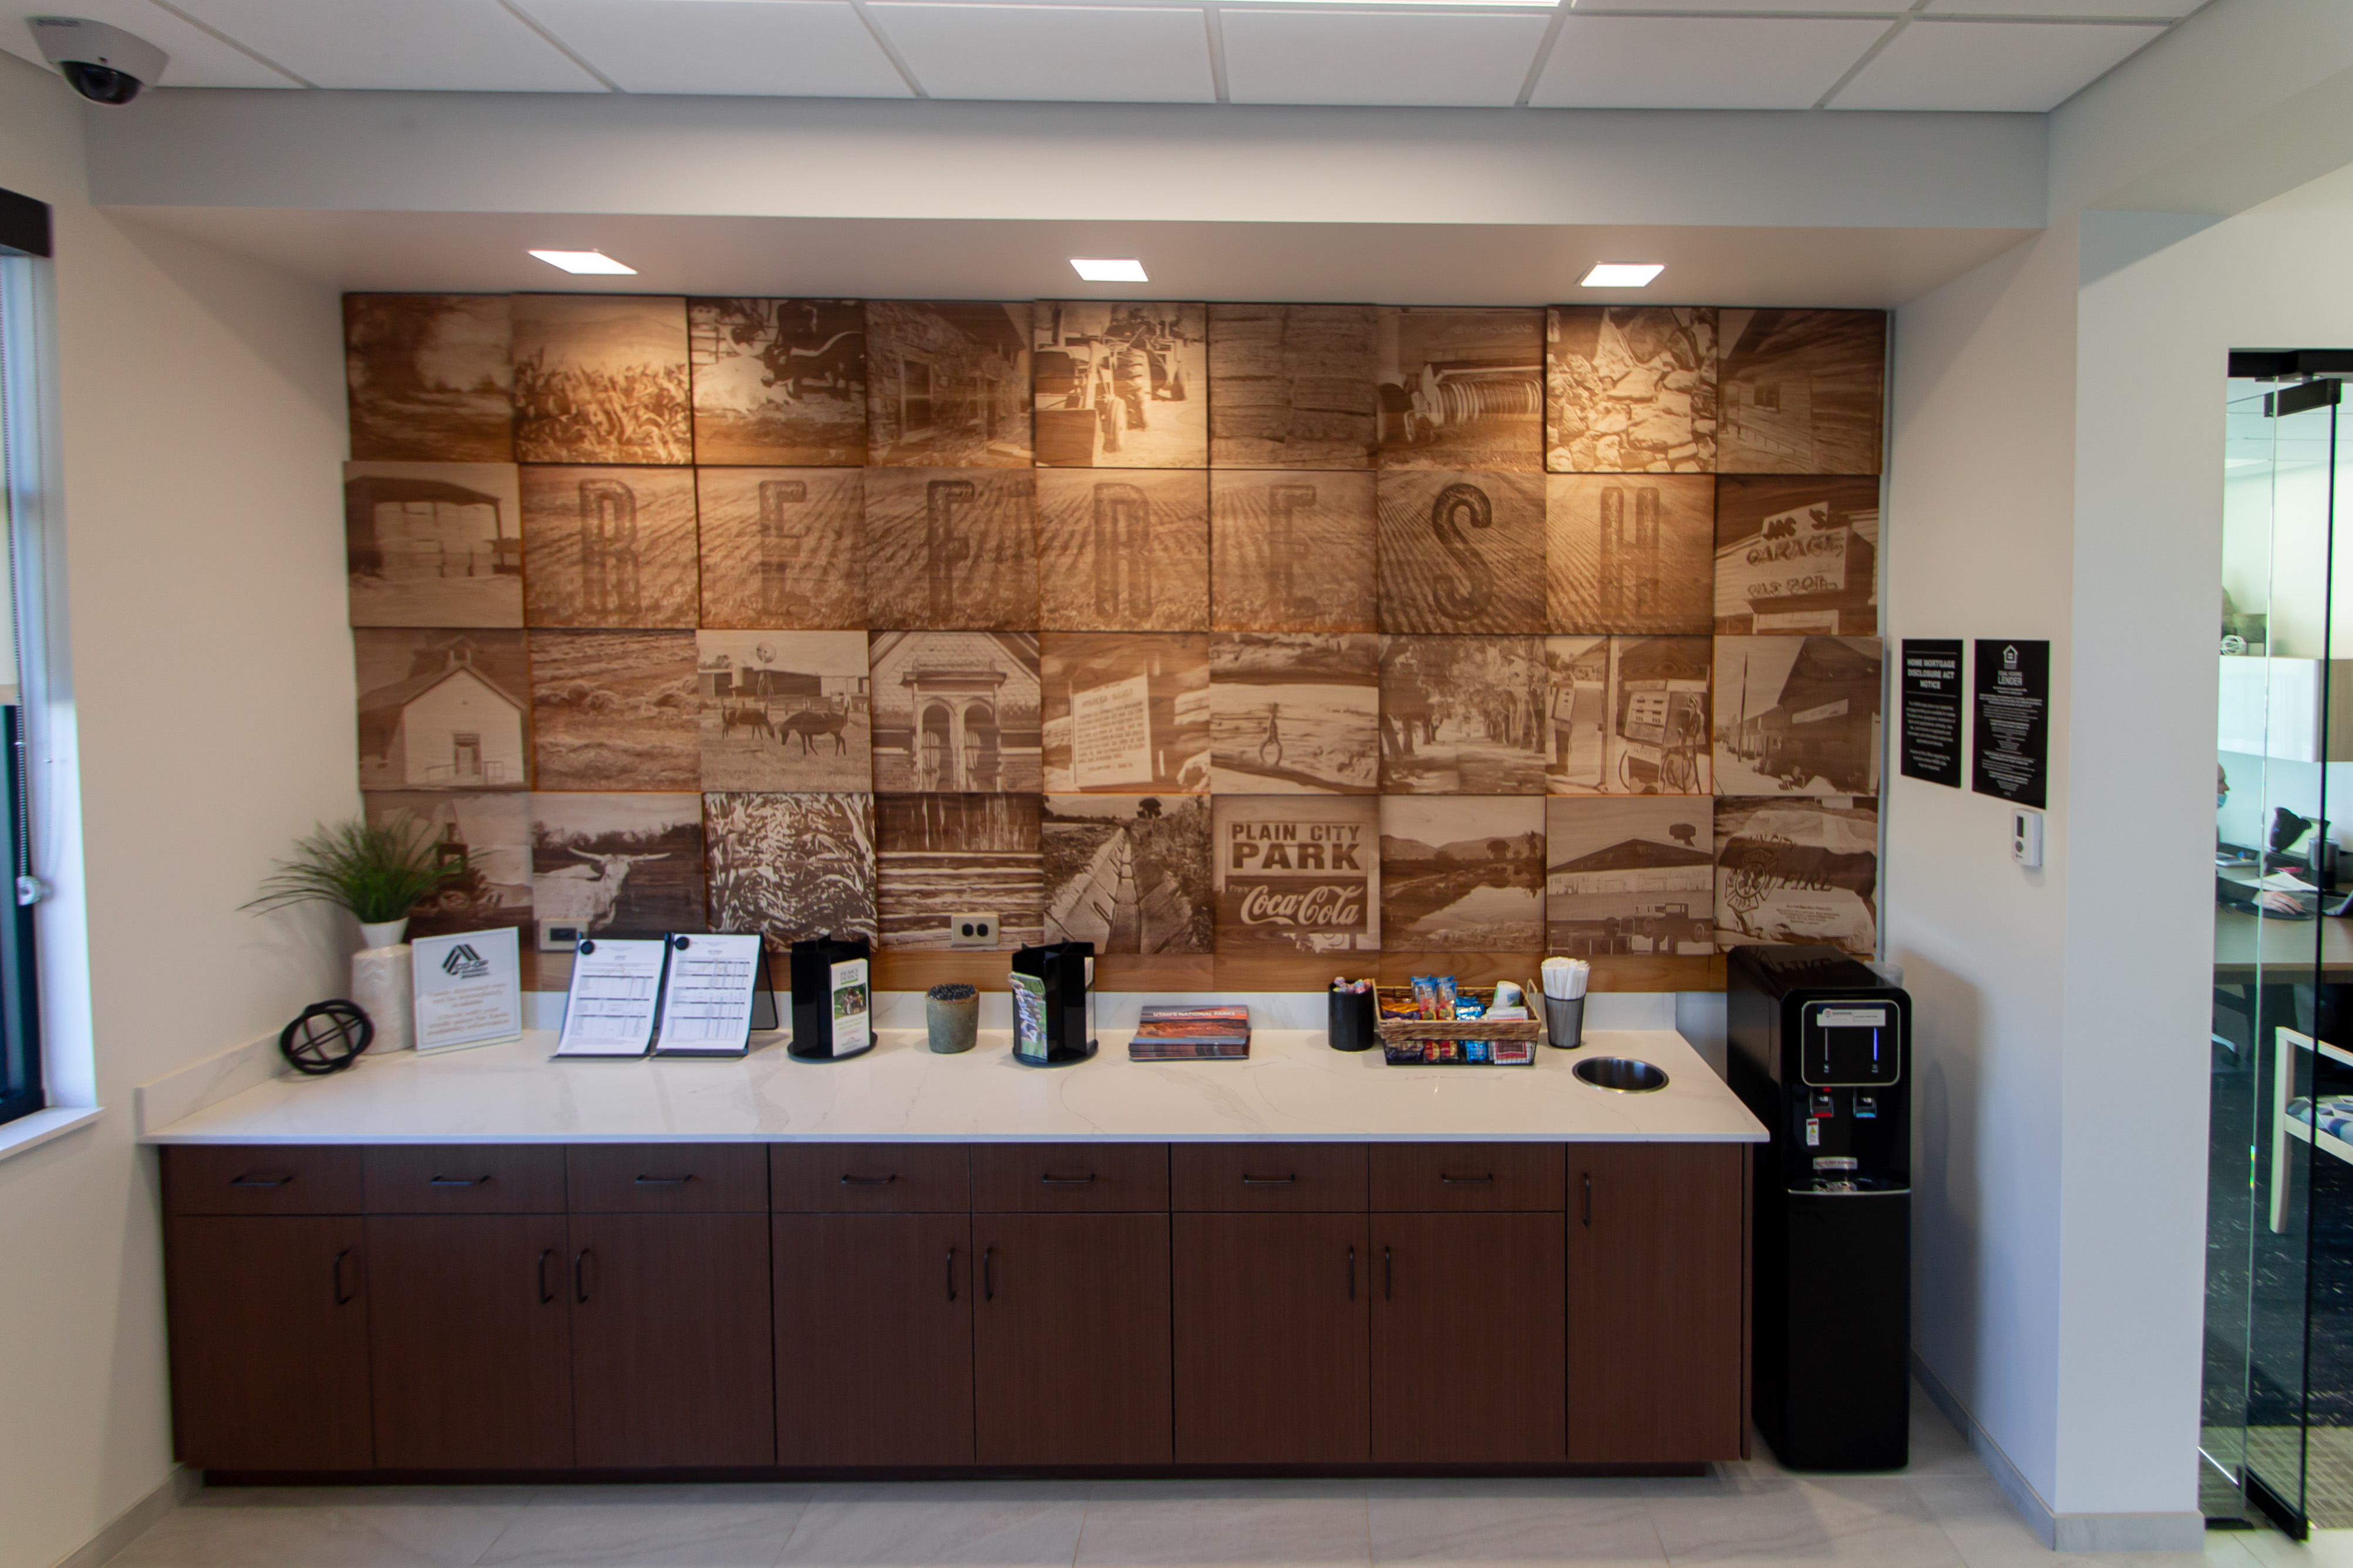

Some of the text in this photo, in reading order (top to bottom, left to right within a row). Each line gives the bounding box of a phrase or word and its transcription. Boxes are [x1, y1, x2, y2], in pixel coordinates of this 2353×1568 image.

[1907, 658, 1955, 669] HOME MORTGAGE
[1907, 668, 1955, 679] DISCLOSURE ACT
[1920, 680, 1941, 689] NOTICE
[1998, 676, 2022, 686] LENDER
[1231, 823, 1361, 841] PLAIN CITY
[1231, 842, 1361, 870] PARK
[1240, 885, 1364, 926] Coca-Cola
